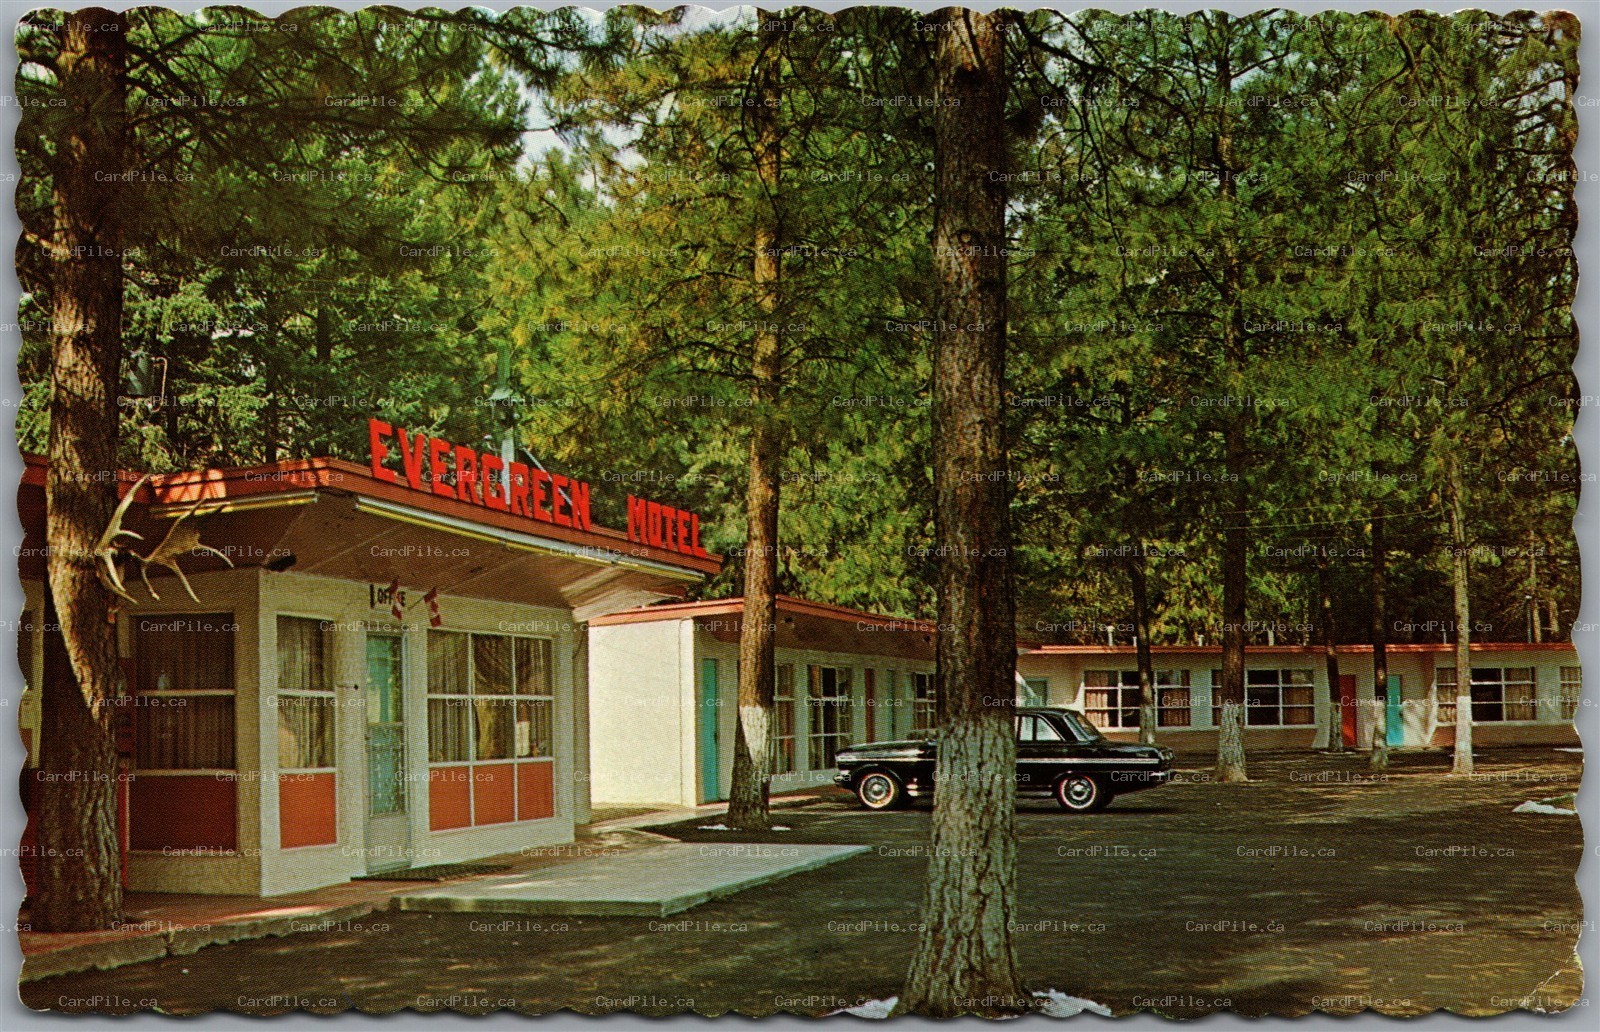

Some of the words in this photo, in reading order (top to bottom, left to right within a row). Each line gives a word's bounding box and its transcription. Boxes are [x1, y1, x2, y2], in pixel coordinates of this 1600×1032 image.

[369, 418, 591, 531] EVERGREEN
[627, 494, 707, 558] MOTEL
[377, 588, 406, 607] OFFE
